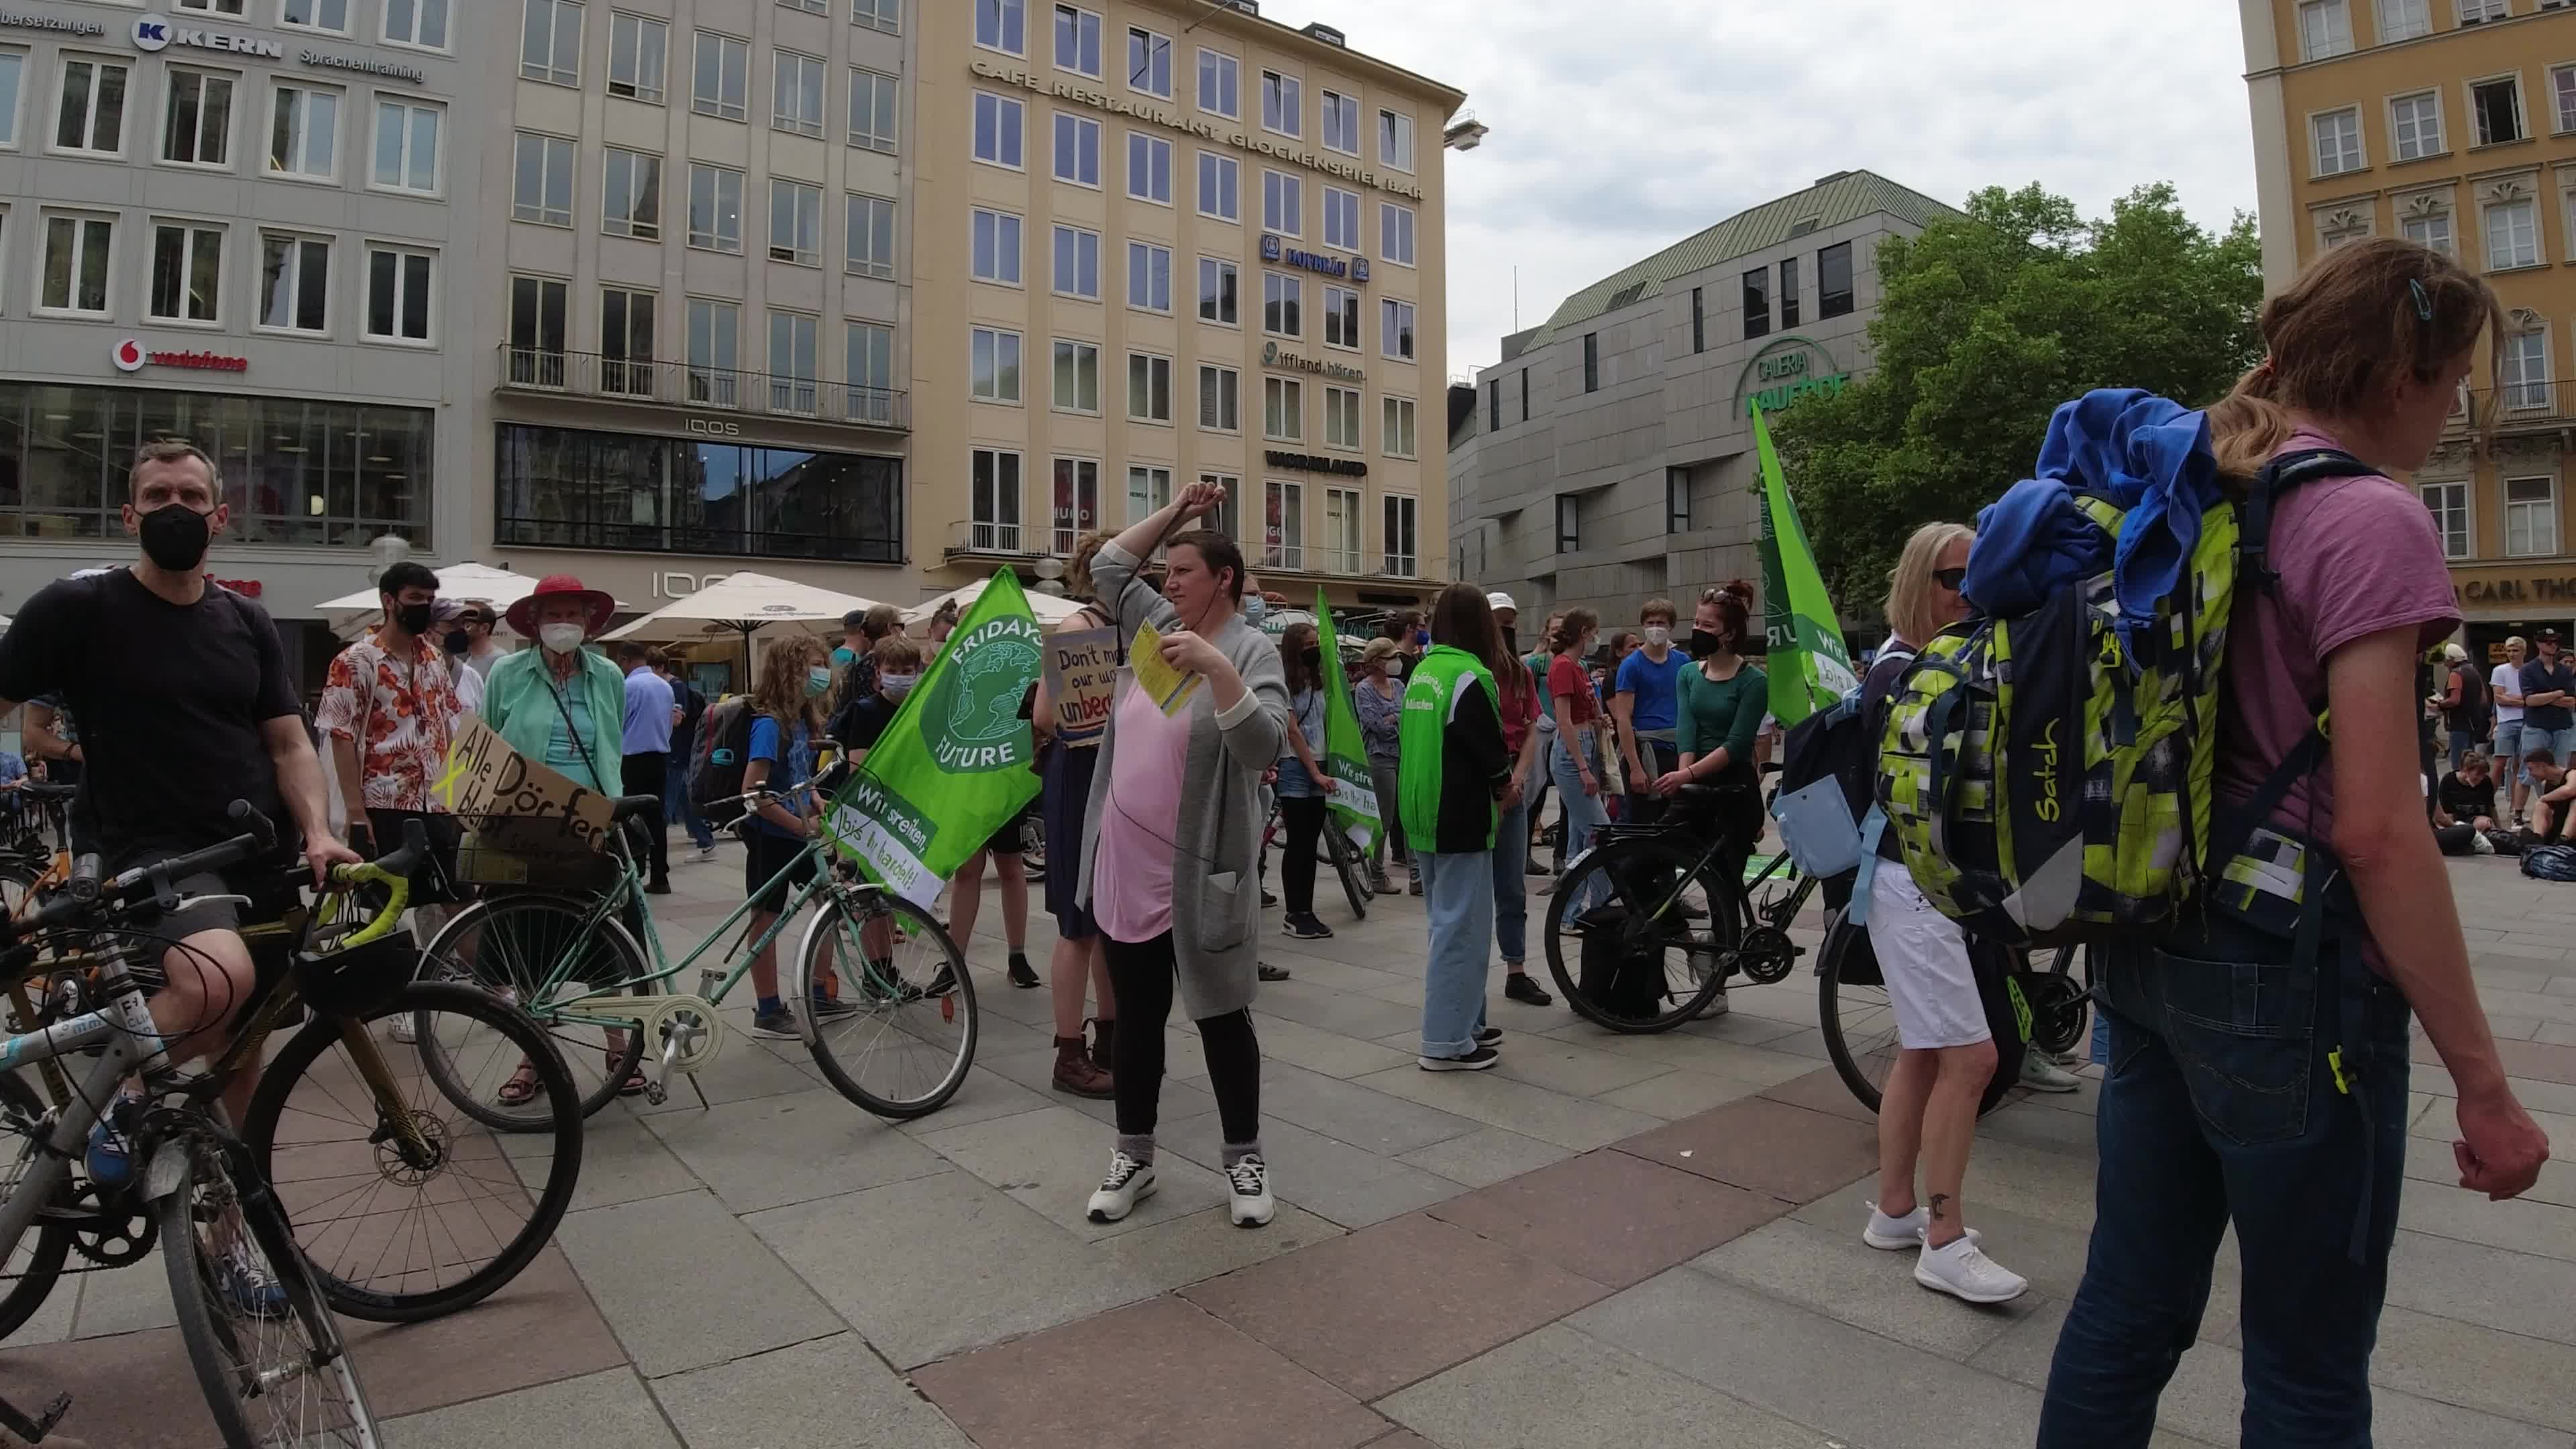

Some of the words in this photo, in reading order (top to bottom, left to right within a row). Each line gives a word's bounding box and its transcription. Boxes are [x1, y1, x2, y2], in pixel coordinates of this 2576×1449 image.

[0, 10, 106, 35] bersetzungen
[176, 28, 282, 58] KERN
[301, 48, 424, 83] Sprachentraining
[153, 350, 247, 372] vodafone
[685, 418, 739, 435] IQOS
[2465, 579, 2528, 601] CARL
[1057, 644, 1100, 670] Don't
[1072, 674, 1093, 688] our
[935, 735, 1015, 767] FUTURE
[1338, 759, 1354, 777] Wir
[456, 724, 492, 782] Alle
[494, 751, 603, 844] Dörfer
[857, 783, 888, 814] Wir
[842, 812, 863, 841] bis
